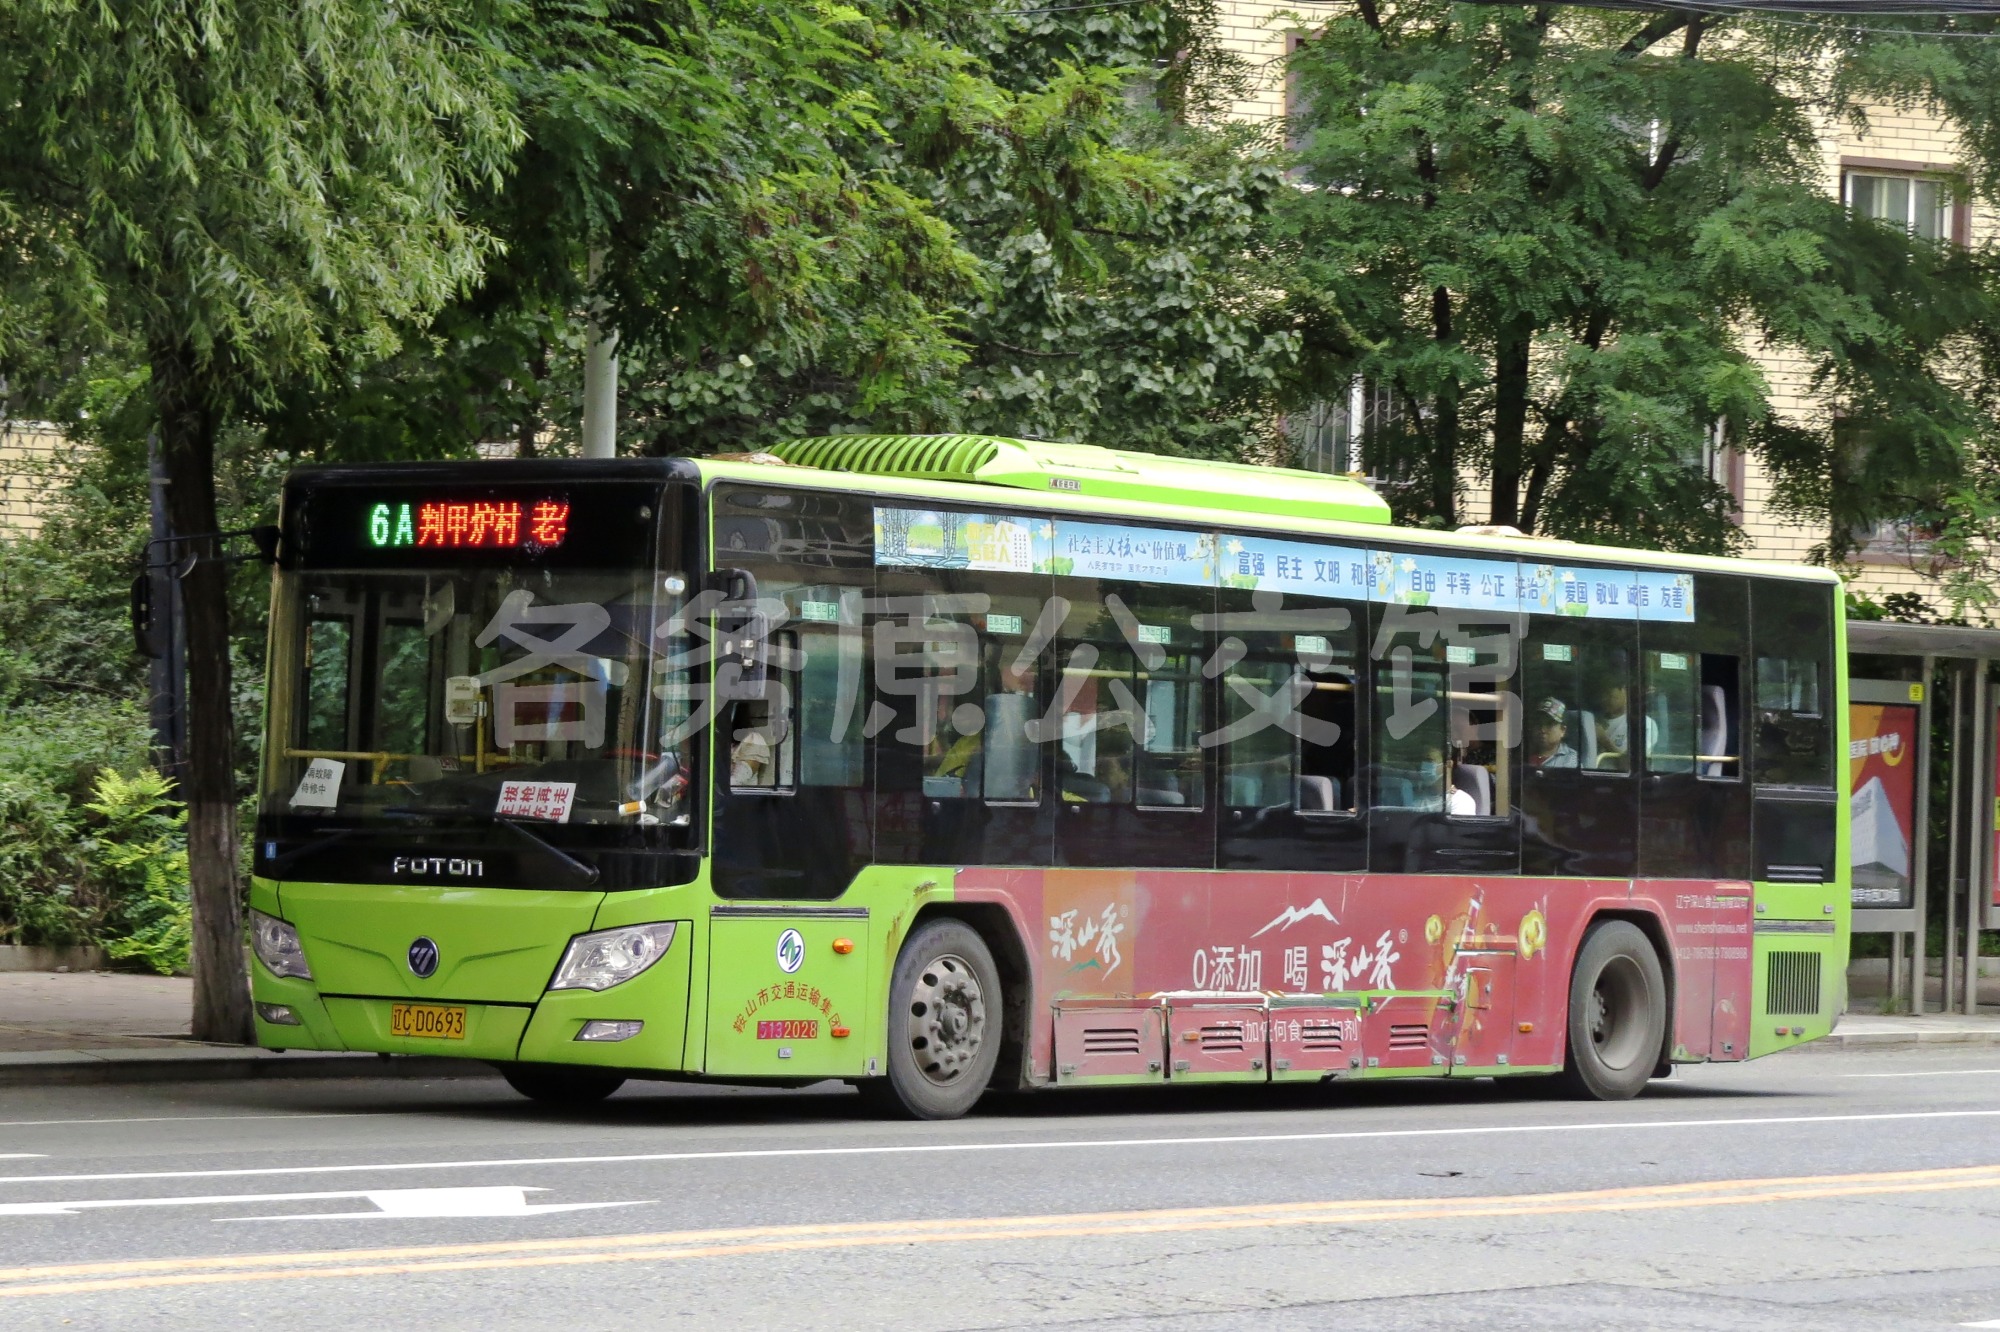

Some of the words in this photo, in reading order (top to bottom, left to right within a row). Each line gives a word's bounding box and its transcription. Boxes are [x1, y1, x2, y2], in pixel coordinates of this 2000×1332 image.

[371, 504, 413, 545] 6A
[418, 503, 521, 545] 判甲炉村
[1068, 533, 1189, 561] 社会主义核心价值观
[1238, 551, 1265, 577] 富强
[1277, 555, 1303, 580] 民主
[1314, 559, 1340, 584] 文明
[1351, 562, 1377, 587] 和谐
[1411, 569, 1436, 592] 自由
[1446, 572, 1471, 595] 平等
[1481, 574, 1505, 597] 公正
[1515, 576, 1539, 599] 法治
[1565, 581, 1588, 603] 爱国
[1596, 583, 1619, 605] 敬业
[1626, 585, 1649, 606] 诚信
[1660, 586, 1683, 608] 友善
[393, 856, 483, 876] FOTON
[1192, 944, 1262, 992] 0添加
[1283, 945, 1308, 992] 喝
[733, 981, 842, 1034] 鞍山市交通运输集团
